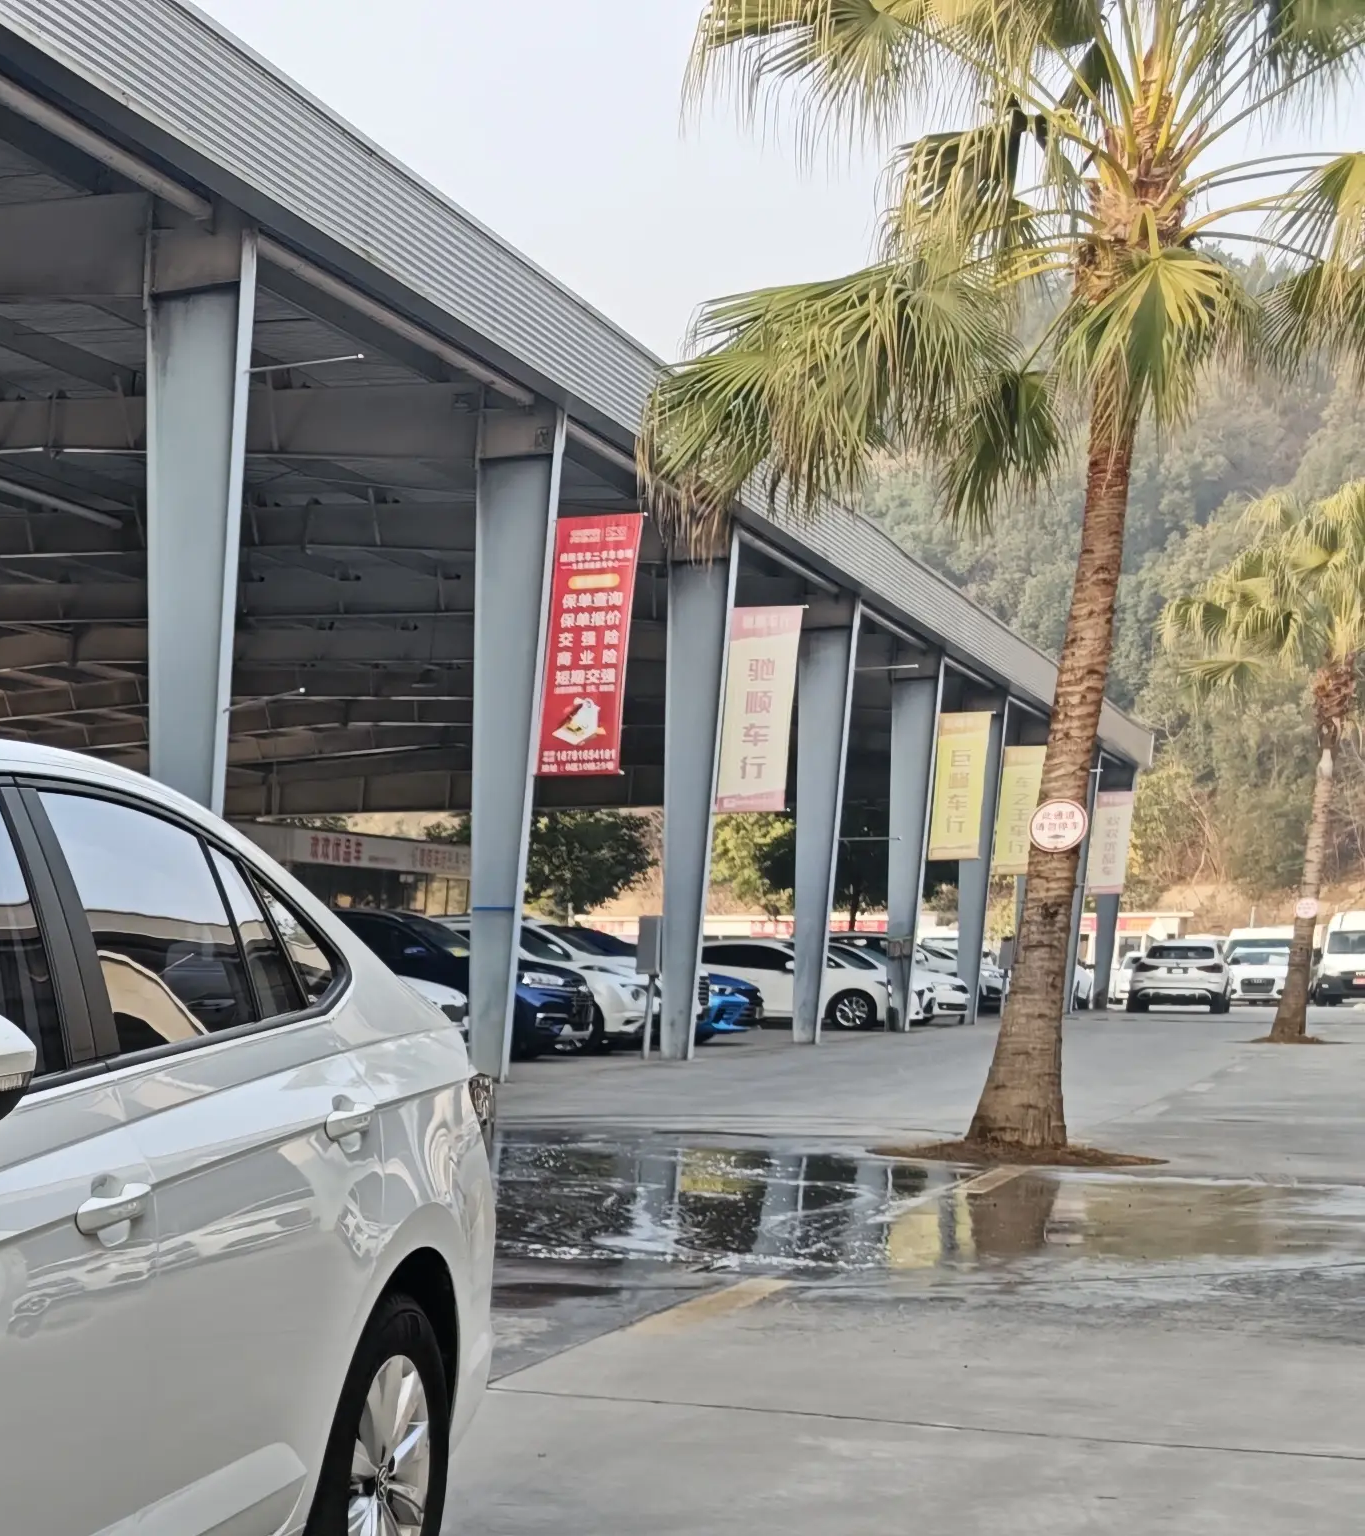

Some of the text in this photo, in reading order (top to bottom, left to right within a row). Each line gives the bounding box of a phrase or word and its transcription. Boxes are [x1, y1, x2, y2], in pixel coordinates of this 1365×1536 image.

[562, 591, 624, 609] 保单查询
[560, 610, 622, 628] 保单报价
[556, 648, 618, 666] 商业险
[740, 658, 776, 780] 驰顺车行
